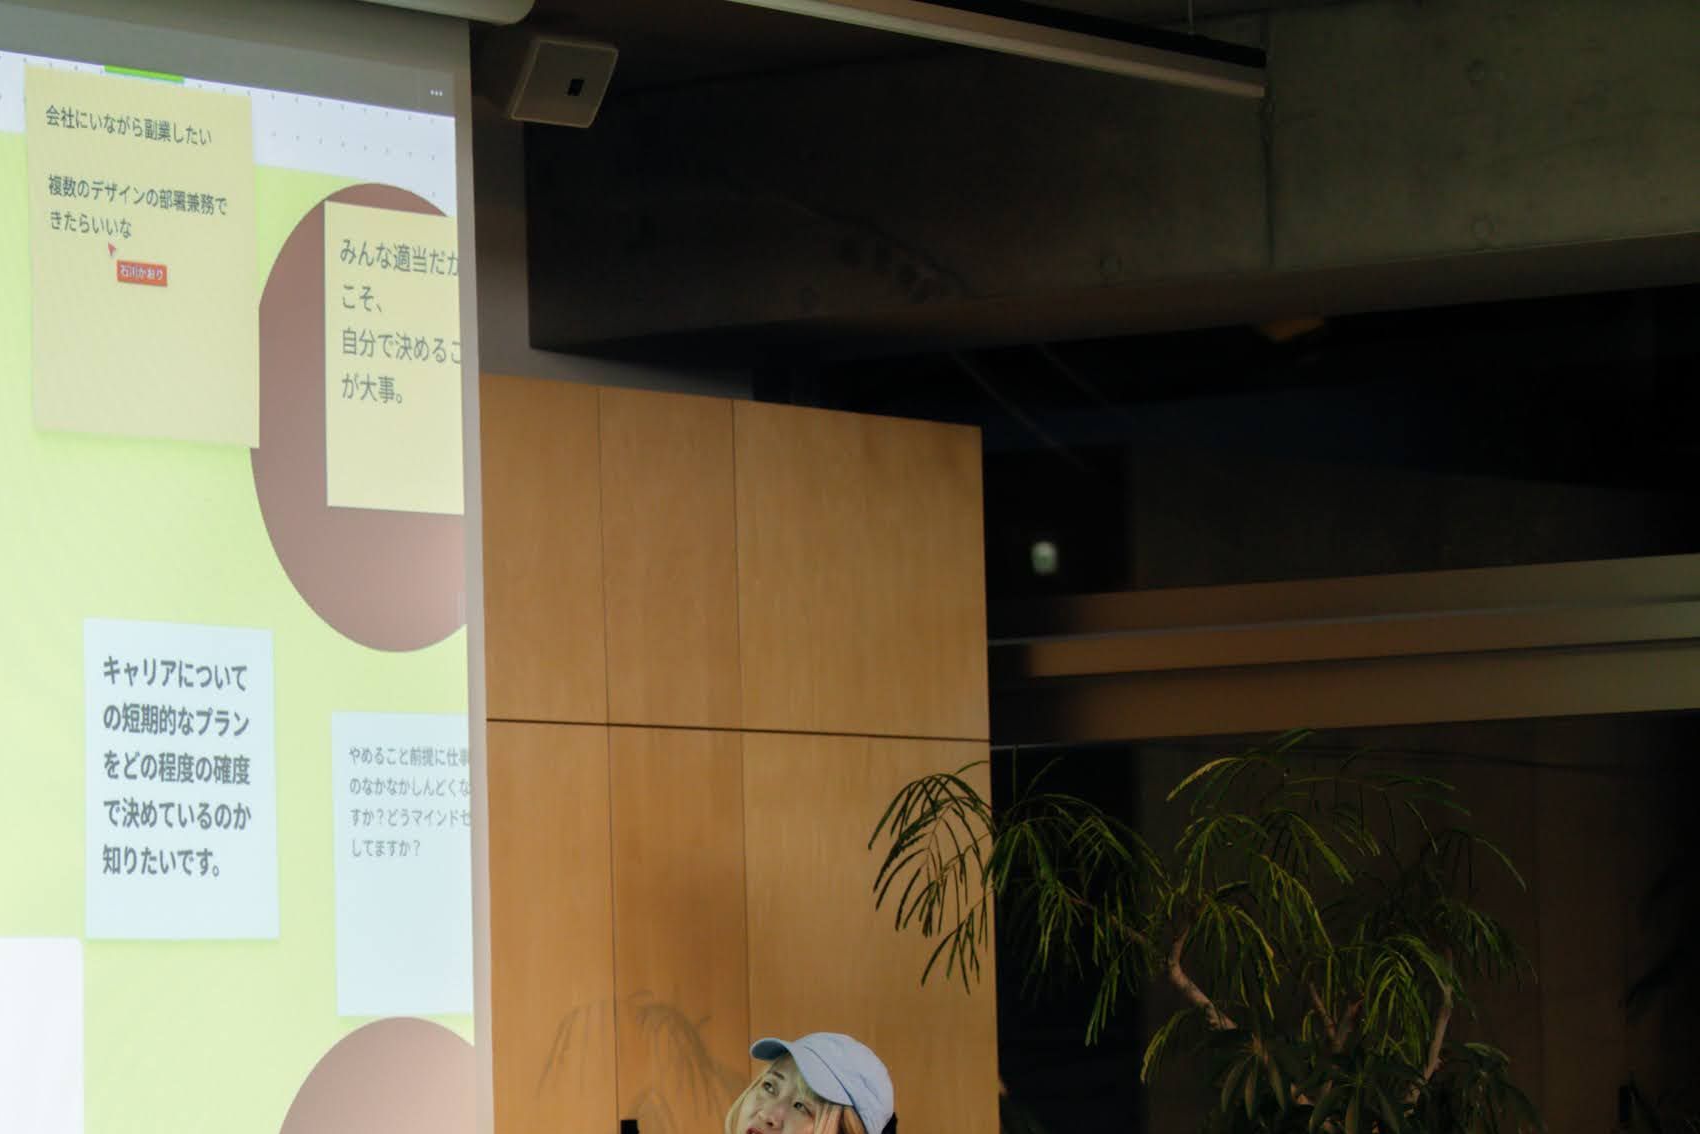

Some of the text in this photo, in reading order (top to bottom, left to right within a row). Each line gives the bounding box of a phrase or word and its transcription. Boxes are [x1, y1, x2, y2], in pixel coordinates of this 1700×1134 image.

[45, 104, 213, 147] 会社にいながら副業したい
[48, 173, 228, 216] 複数のデザインの部署兼務で
[49, 210, 133, 239] きたらいいな
[342, 284, 383, 313] こそ、
[342, 327, 461, 365] 自分で決めるこ
[341, 373, 402, 404] が大事。
[103, 656, 248, 691] キャリアについて
[103, 703, 249, 738] の短期的なプラン
[104, 750, 250, 785] をどの程度の確度
[104, 797, 251, 830] で決めているのか
[103, 844, 220, 877] 知りたいです。
[351, 838, 421, 857] してますか？
